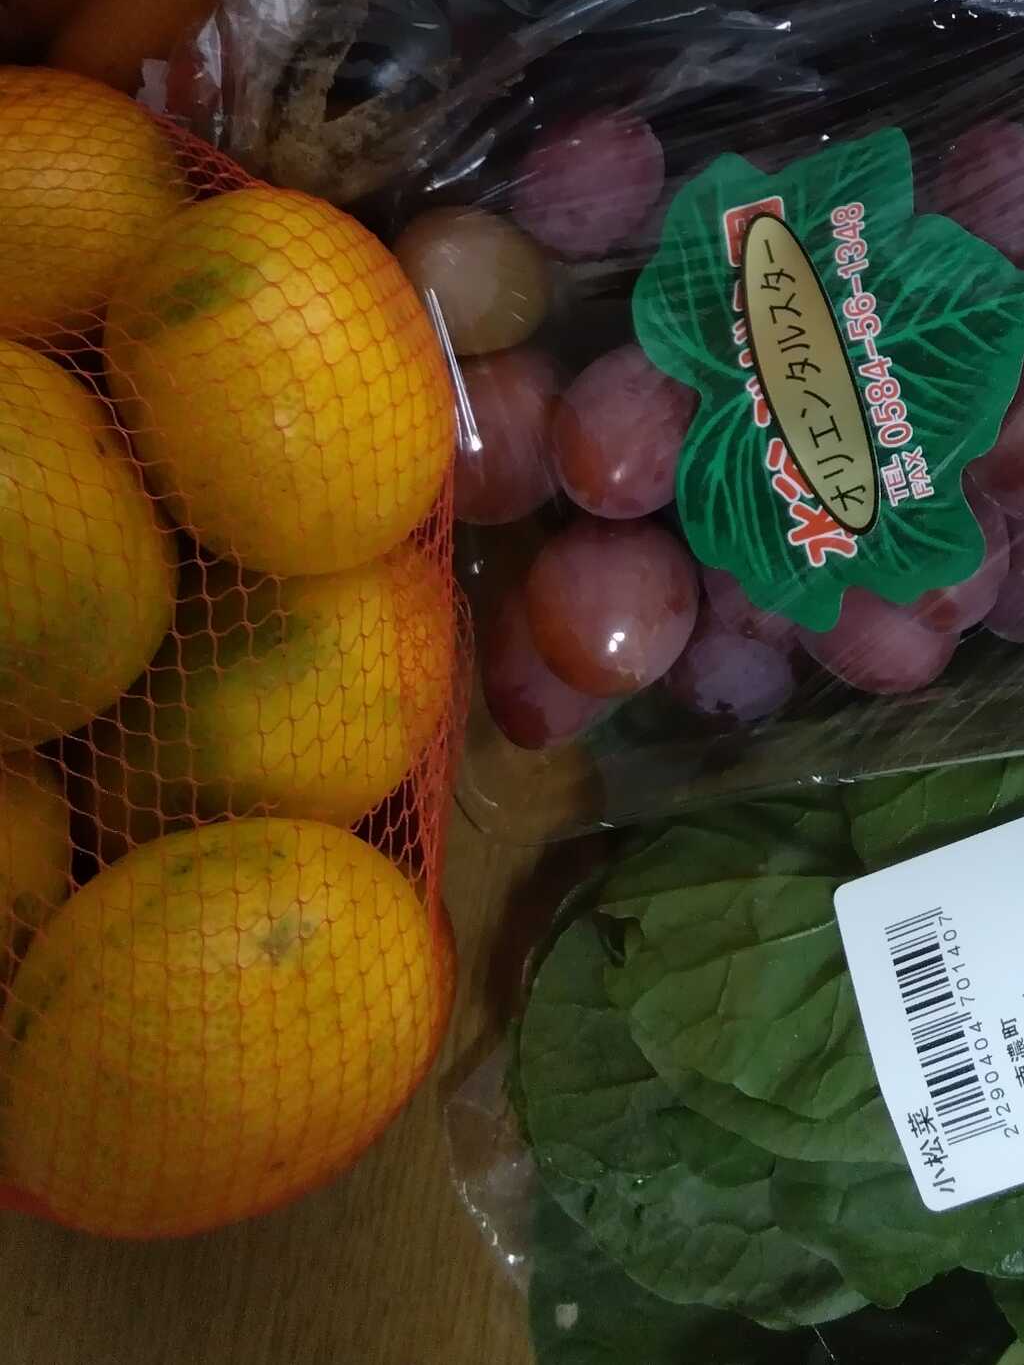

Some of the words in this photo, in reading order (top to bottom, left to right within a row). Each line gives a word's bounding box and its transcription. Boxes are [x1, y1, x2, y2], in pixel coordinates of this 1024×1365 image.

[830, 201, 914, 449] 0584-56-1348
[760, 238, 867, 513] オリエンタルスター
[881, 453, 908, 506] TEL
[903, 445, 934, 499] FAX
[938, 915, 976, 1007] 701407
[969, 1021, 1013, 1117] 290404
[907, 1105, 956, 1194] 小松菜
